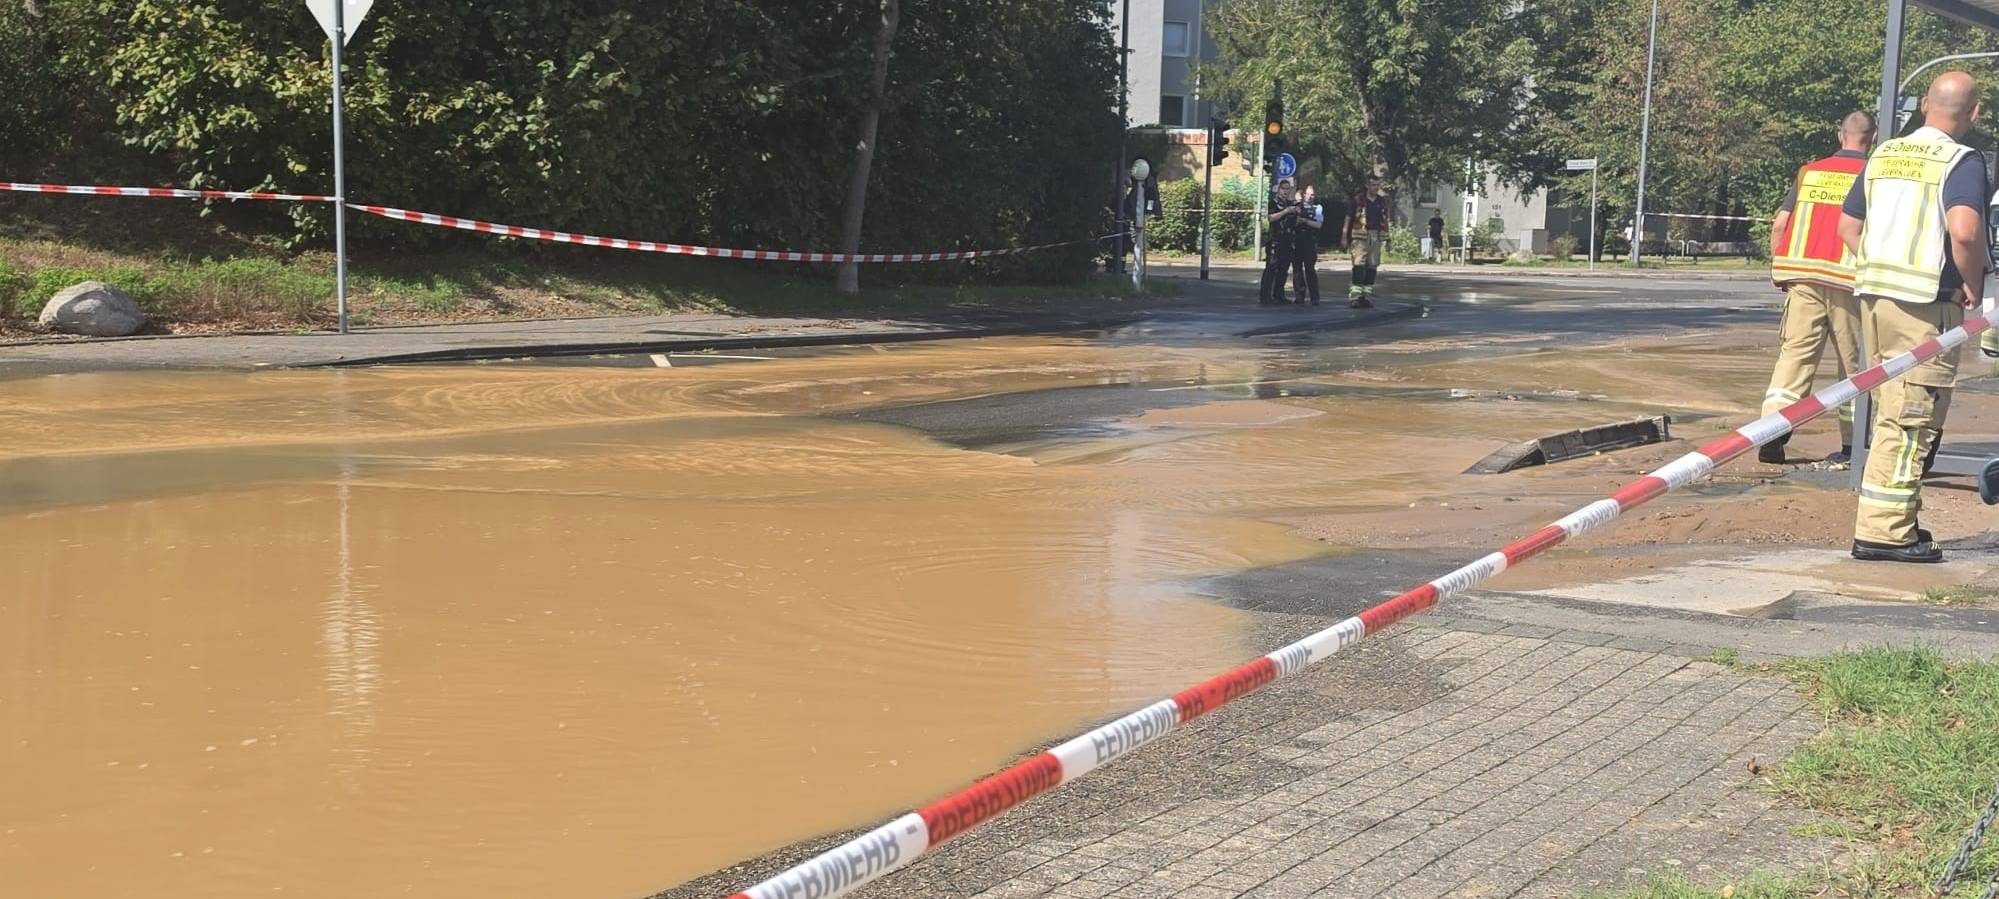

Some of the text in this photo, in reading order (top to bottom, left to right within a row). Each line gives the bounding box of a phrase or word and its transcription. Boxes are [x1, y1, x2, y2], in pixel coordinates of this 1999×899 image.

[1883, 142, 1943, 156] B-Dienst 2
[1809, 190, 1846, 201] C-Diens
